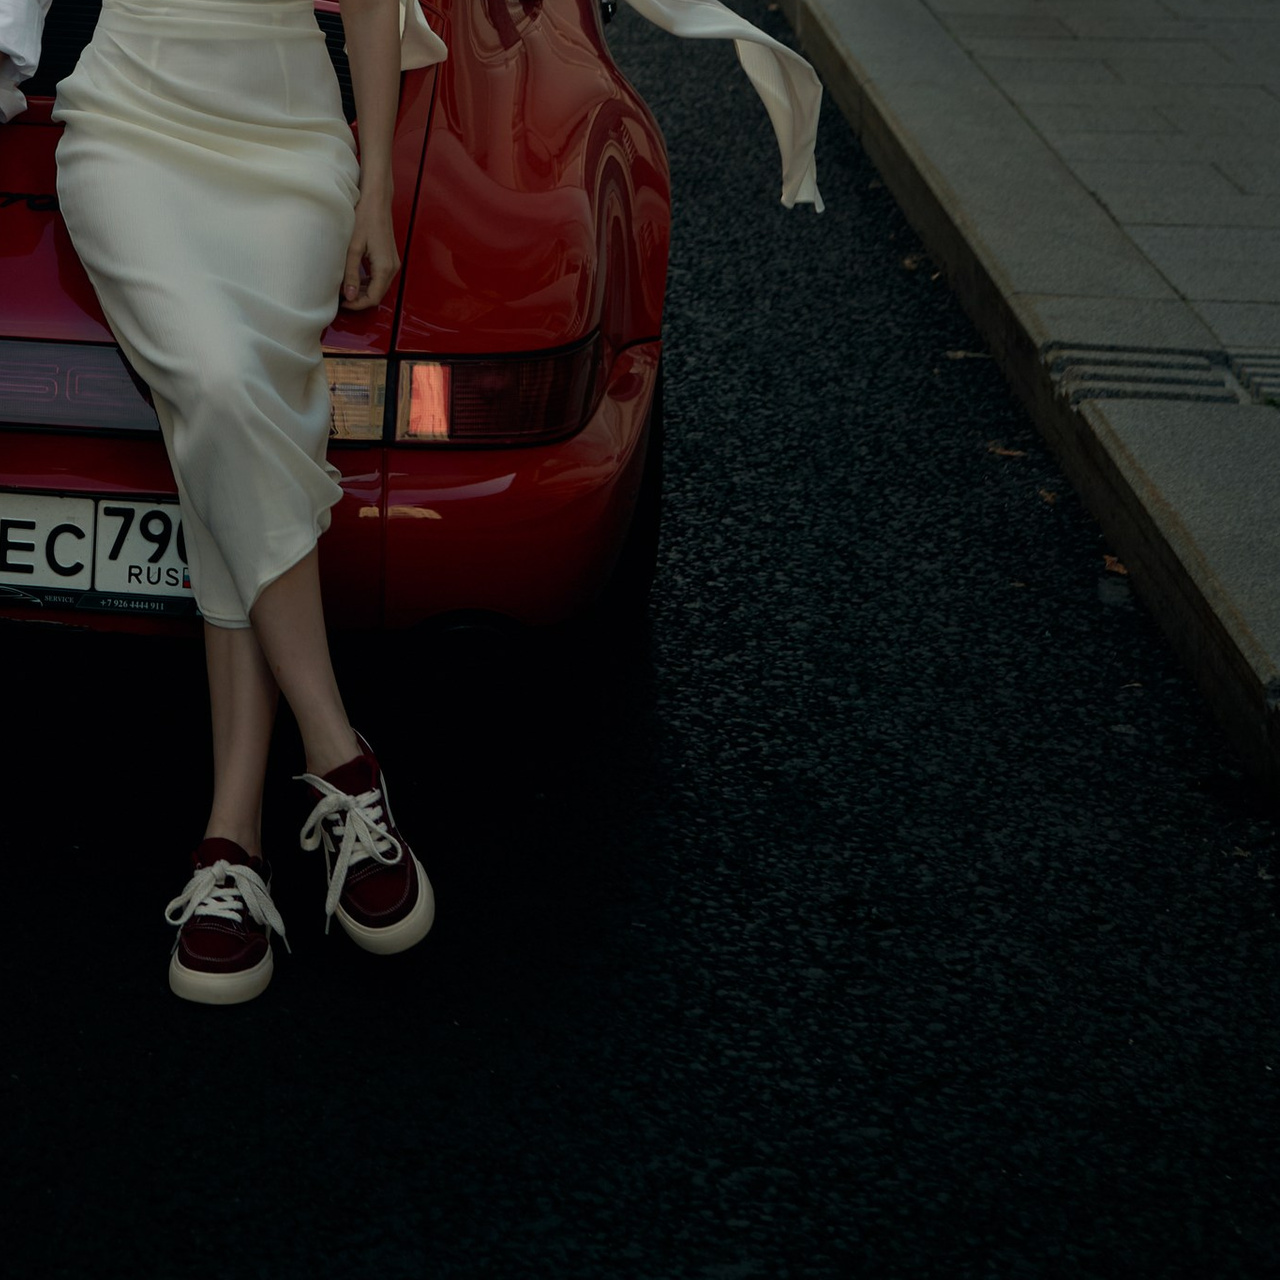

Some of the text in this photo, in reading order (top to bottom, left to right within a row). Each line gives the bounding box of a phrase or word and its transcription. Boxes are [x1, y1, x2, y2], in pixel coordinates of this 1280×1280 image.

[103, 506, 188, 565] 79
[128, 565, 179, 586] RUS
[113, 599, 128, 609] 926
[129, 600, 149, 610] 4444
[150, 601, 164, 611] 911
